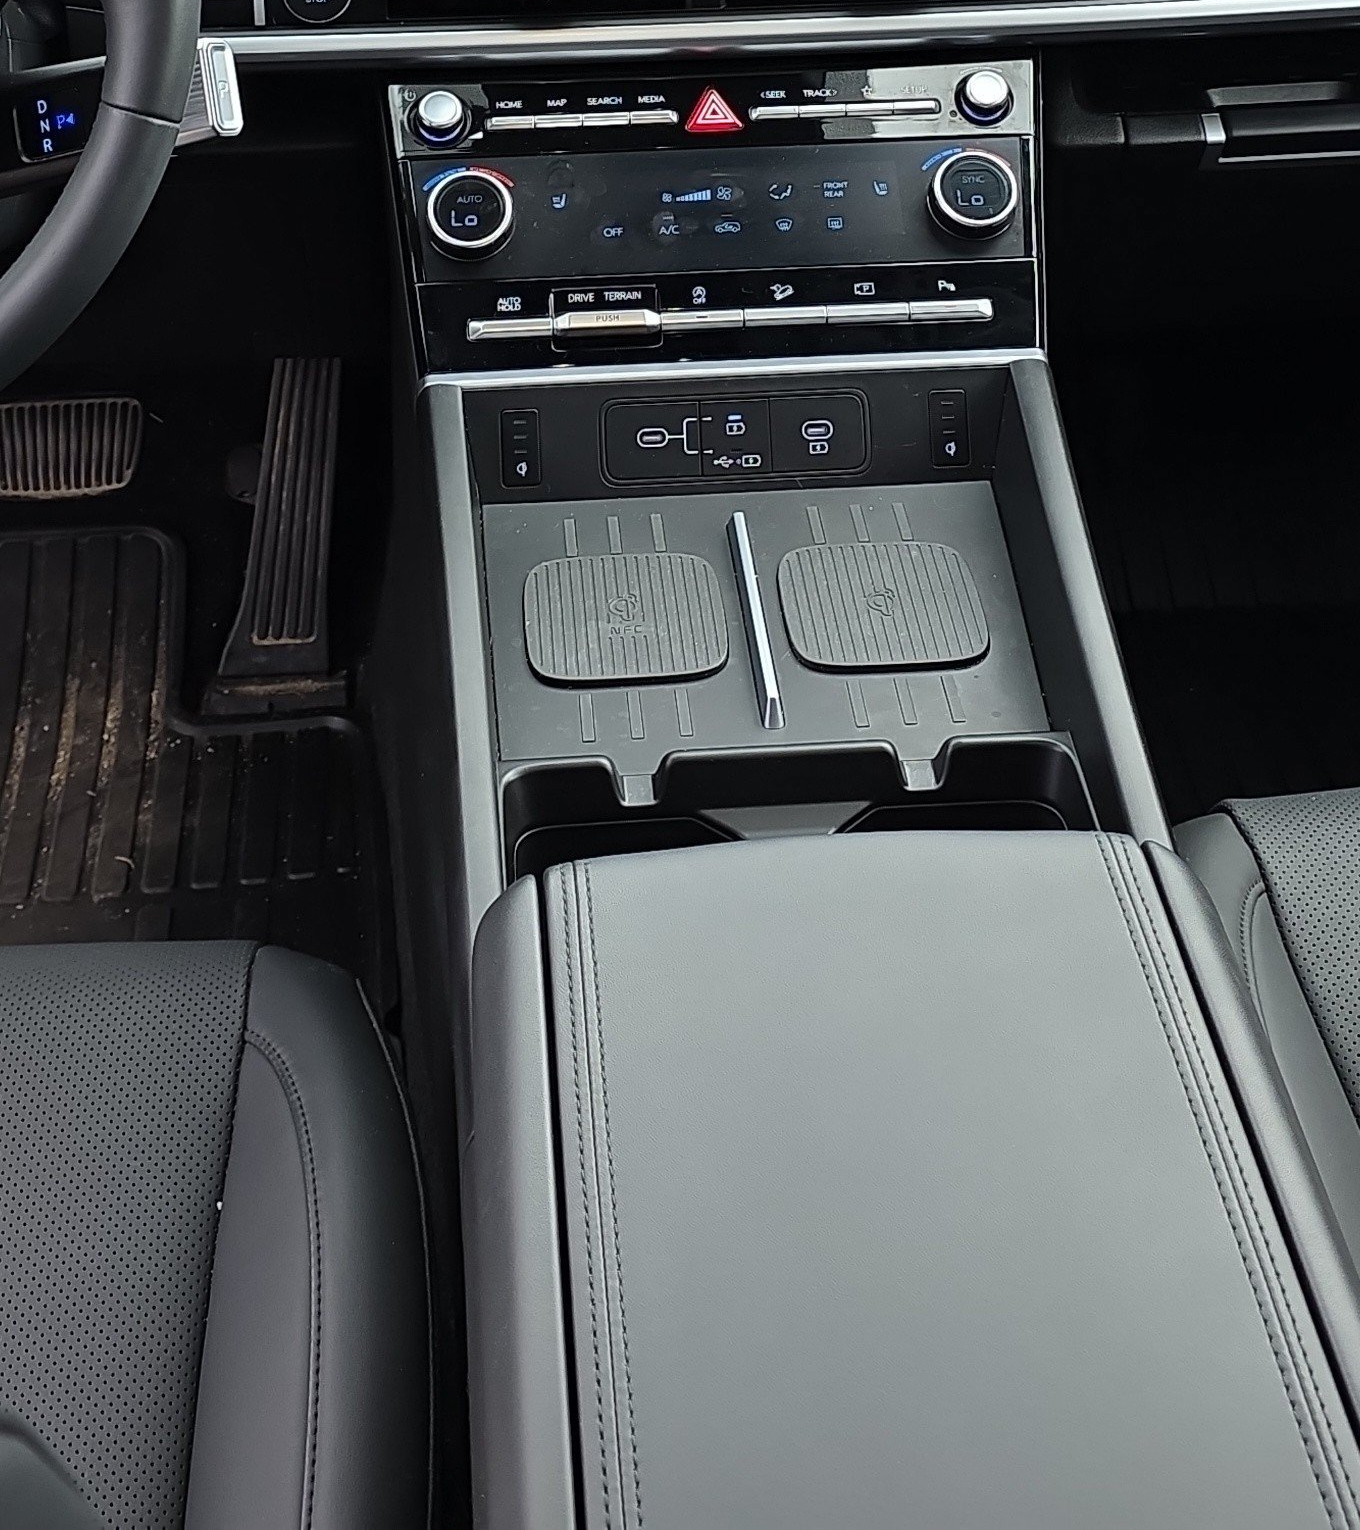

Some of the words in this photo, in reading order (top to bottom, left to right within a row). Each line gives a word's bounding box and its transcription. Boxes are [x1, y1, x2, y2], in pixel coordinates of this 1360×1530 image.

[546, 98, 567, 107] MAP
[586, 96, 623, 106] SEARCH
[637, 94, 666, 104] MEDIA
[36, 100, 47, 114] D
[495, 100, 523, 109] HOME
[39, 118, 51, 133] N
[42, 138, 53, 153] R
[962, 175, 985, 184] SYNC
[823, 181, 848, 190] FRONT
[823, 190, 844, 198] REAR
[957, 189, 985, 206] Lo
[456, 194, 483, 205] AUTO
[451, 210, 478, 227] Lo
[603, 227, 624, 237] OFF
[659, 224, 680, 236] A/C
[497, 297, 521, 305] AUTO
[568, 292, 595, 303] DRIVE
[603, 291, 642, 302] TERRAIN
[497, 304, 521, 312] HOLD
[595, 314, 620, 322] PUSH
[610, 624, 643, 635] NFC
